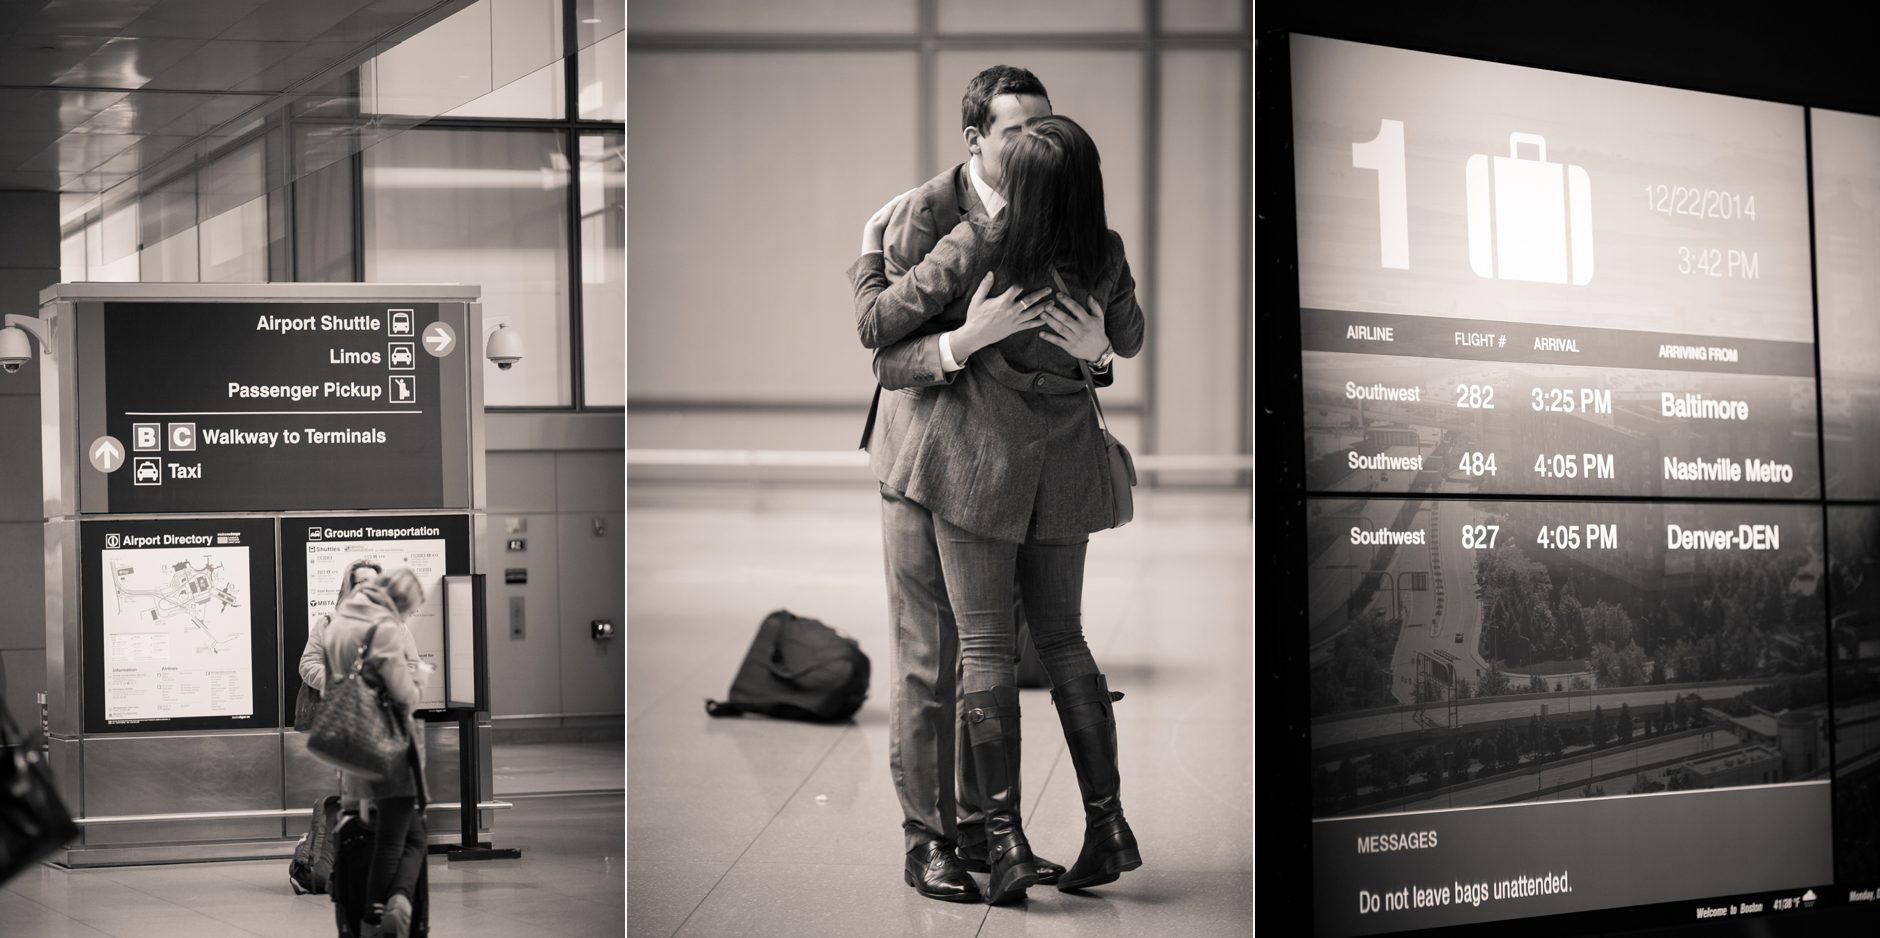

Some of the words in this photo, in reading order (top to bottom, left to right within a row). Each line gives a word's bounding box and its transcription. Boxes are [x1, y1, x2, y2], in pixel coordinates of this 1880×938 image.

[1352, 119, 1410, 270] 1
[1645, 184, 1756, 221] 12/22/2014
[1678, 246, 1721, 277] 3:42
[1728, 250, 1758, 279] PM
[257, 314, 316, 334] Airport
[321, 315, 380, 330] Shuttle
[1347, 325, 1394, 341] AIRLINE
[1455, 332, 1495, 347] FLIGHT
[1498, 335, 1506, 347] #
[1534, 337, 1579, 352] ARRIVAL
[1659, 345, 1707, 360] ARRIVING
[1708, 347, 1738, 362] FROM
[330, 349, 381, 363] Limos
[229, 383, 319, 401] Passenger
[324, 382, 381, 400] Pickup
[1346, 382, 1421, 402] Southwest
[1457, 384, 1496, 408] 282
[1532, 387, 1574, 412] 3:25
[1581, 388, 1614, 414] PM
[1660, 392, 1748, 420] Baltimore
[138, 427, 155, 447] B
[173, 426, 192, 446] C
[203, 429, 278, 447] Walkway
[283, 430, 300, 444] to
[304, 428, 386, 443] Terminals
[168, 463, 201, 478] Taxi
[1349, 450, 1424, 470] Southwest
[1459, 452, 1497, 476] 484
[1534, 454, 1577, 478] 4:05
[1583, 454, 1614, 478] PM
[1664, 457, 1741, 481] Nashville
[1745, 458, 1793, 482] Metro
[123, 536, 160, 547] Airport
[164, 535, 212, 546] Directory
[324, 528, 363, 538] Ground
[366, 527, 439, 538] Transportation
[1351, 525, 1425, 545] Southwest
[1462, 525, 1499, 549] 827
[1537, 525, 1580, 549] 4:05
[1587, 524, 1617, 549] PM
[1668, 524, 1779, 550] Denver-DEN
[1358, 830, 1437, 853] MESSAGES
[1360, 891, 1380, 913] Do
[1386, 888, 1409, 911] not
[1413, 886, 1450, 908] leave
[1455, 881, 1488, 906] bags
[1494, 871, 1572, 899] unattended.
[1850, 890, 1875, 901] Monday,
[1697, 907, 1727, 918] Welcome
[1730, 905, 1737, 915] to
[1740, 903, 1763, 914] Boston
